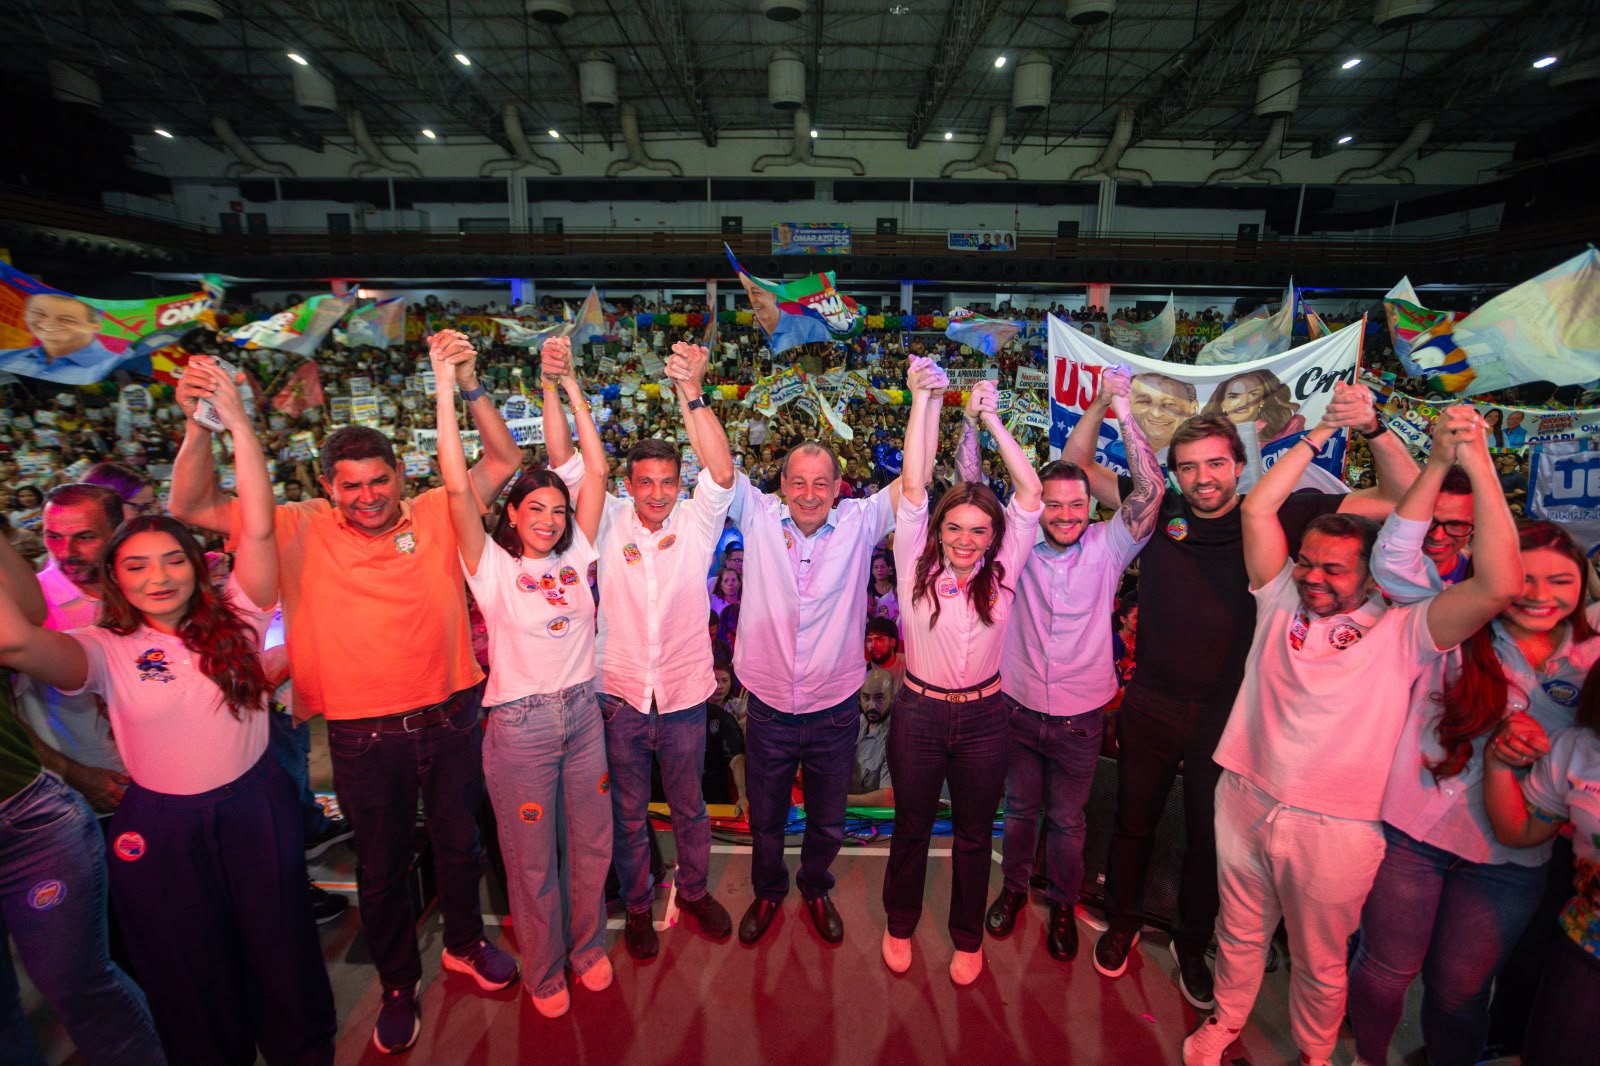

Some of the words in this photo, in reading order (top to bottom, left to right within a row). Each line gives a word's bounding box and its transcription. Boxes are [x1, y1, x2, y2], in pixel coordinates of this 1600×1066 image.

[834, 235, 849, 245] 55
[1189, 326, 1210, 335] COM
[1026, 415, 1049, 426] OMAR
[1581, 424, 1600, 432] OM
